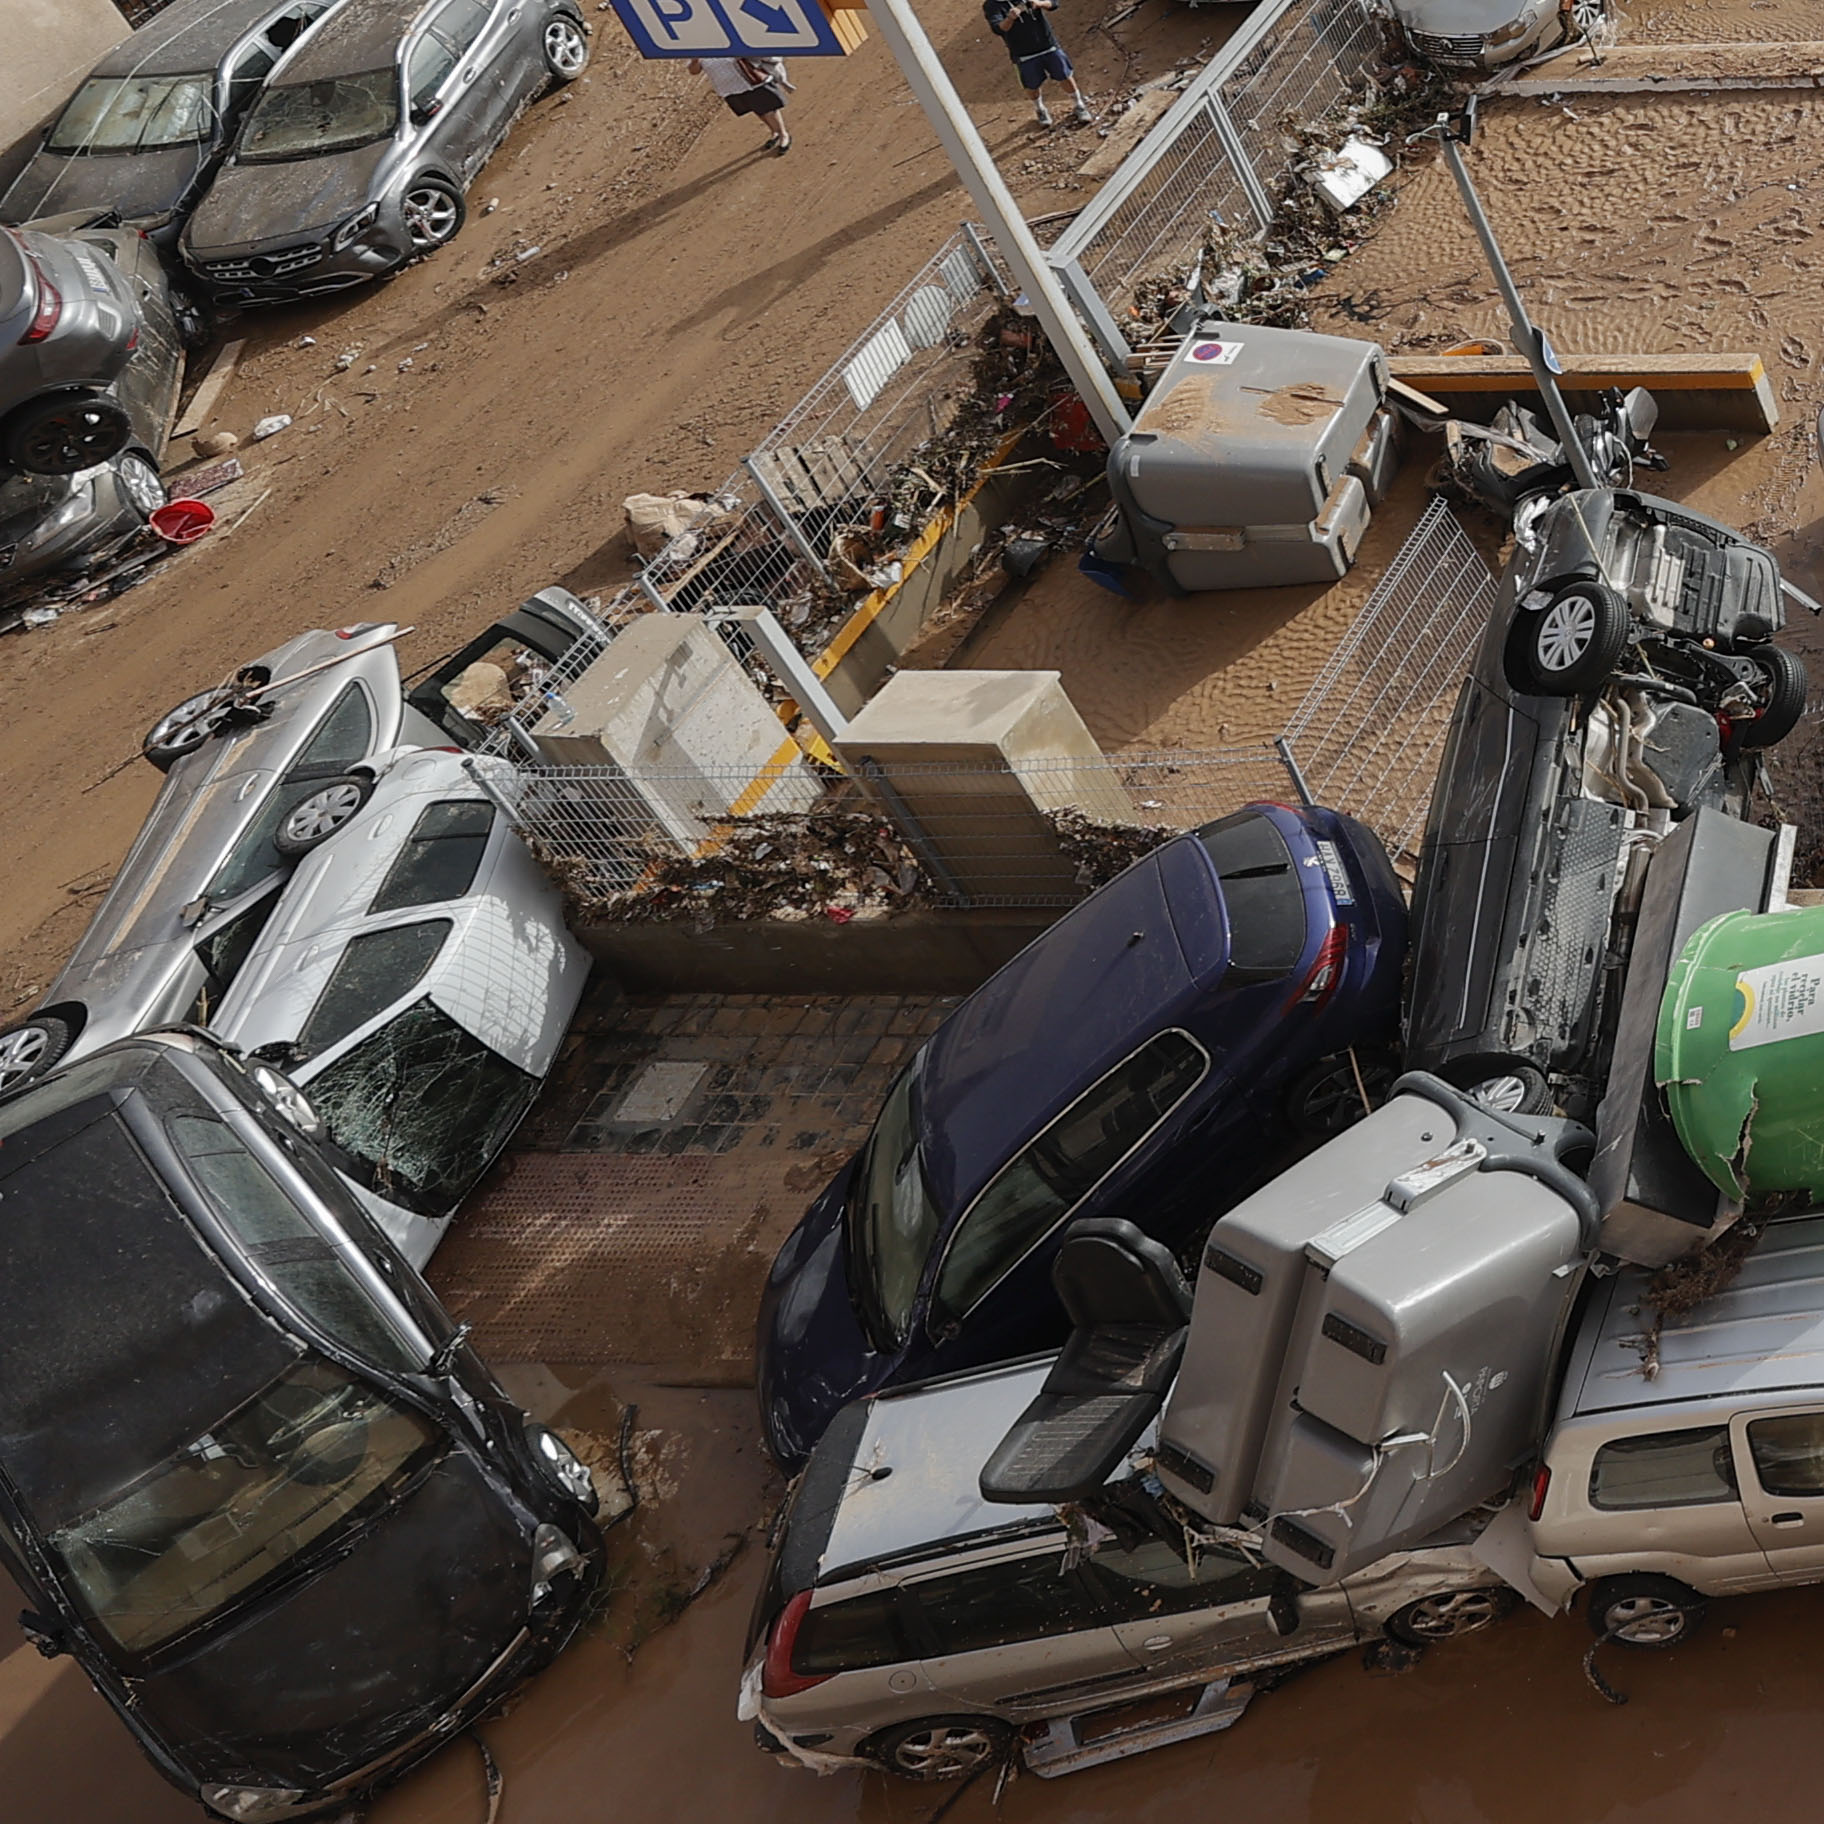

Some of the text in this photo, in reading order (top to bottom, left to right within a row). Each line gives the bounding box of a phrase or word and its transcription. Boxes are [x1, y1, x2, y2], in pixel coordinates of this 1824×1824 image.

[1327, 867, 1347, 896] 8962
[1785, 984, 1797, 1022] vidrio,
[1797, 973, 1809, 1016] reciclar
[1808, 977, 1821, 1006] Para
